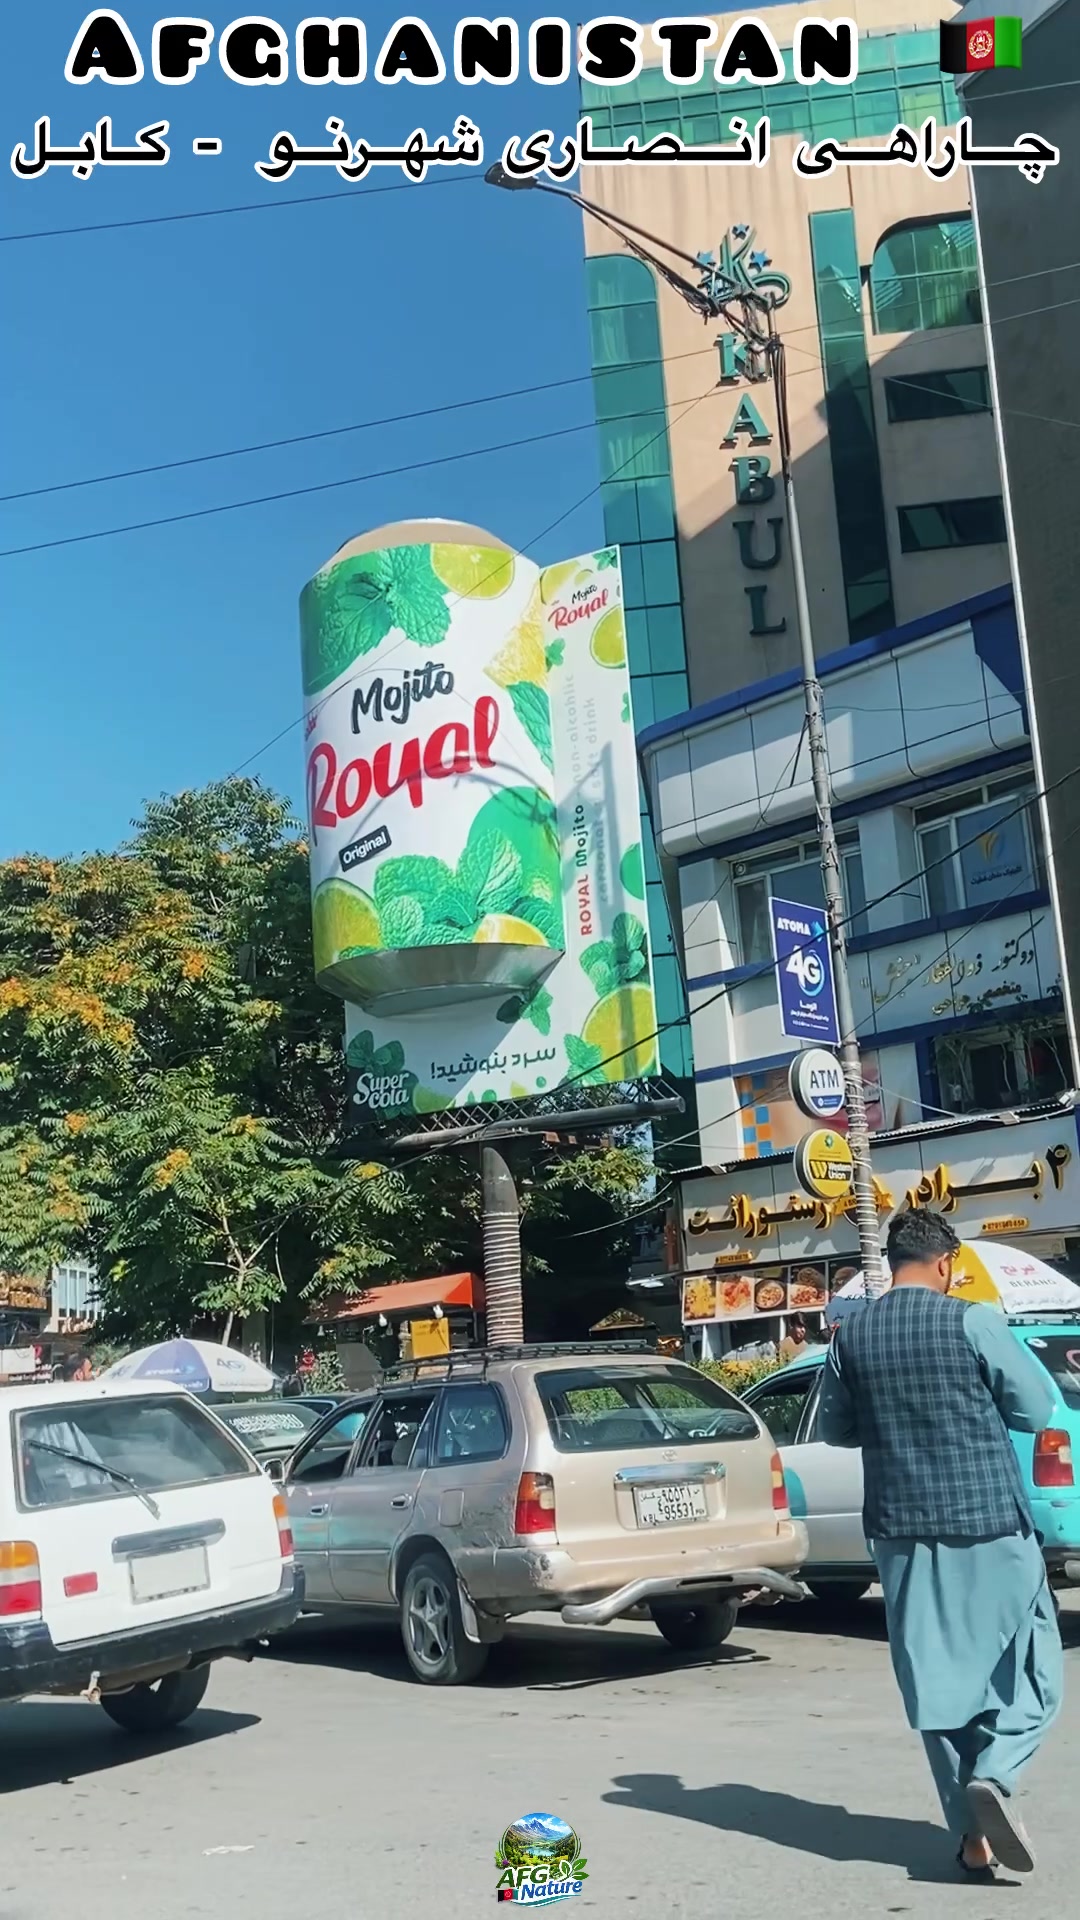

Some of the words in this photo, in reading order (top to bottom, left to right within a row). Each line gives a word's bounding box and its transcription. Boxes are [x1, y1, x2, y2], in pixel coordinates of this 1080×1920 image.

[716, 332, 787, 637] KABUL
[547, 588, 609, 631] Royal
[571, 584, 598, 605] Mojito
[351, 660, 455, 735] Mojito
[307, 695, 501, 840] Royal
[341, 831, 388, 866] Original
[577, 873, 593, 936] ROYAL
[777, 917, 811, 936] ATOMA
[785, 945, 820, 988] 4G
[512, 1046, 557, 1069] سرد
[353, 1072, 410, 1105] Super
[809, 1069, 840, 1089] ATM
[828, 1170, 848, 1181] Union
[688, 1193, 833, 1239] رستورانت
[664, 1501, 695, 1521] 95531
